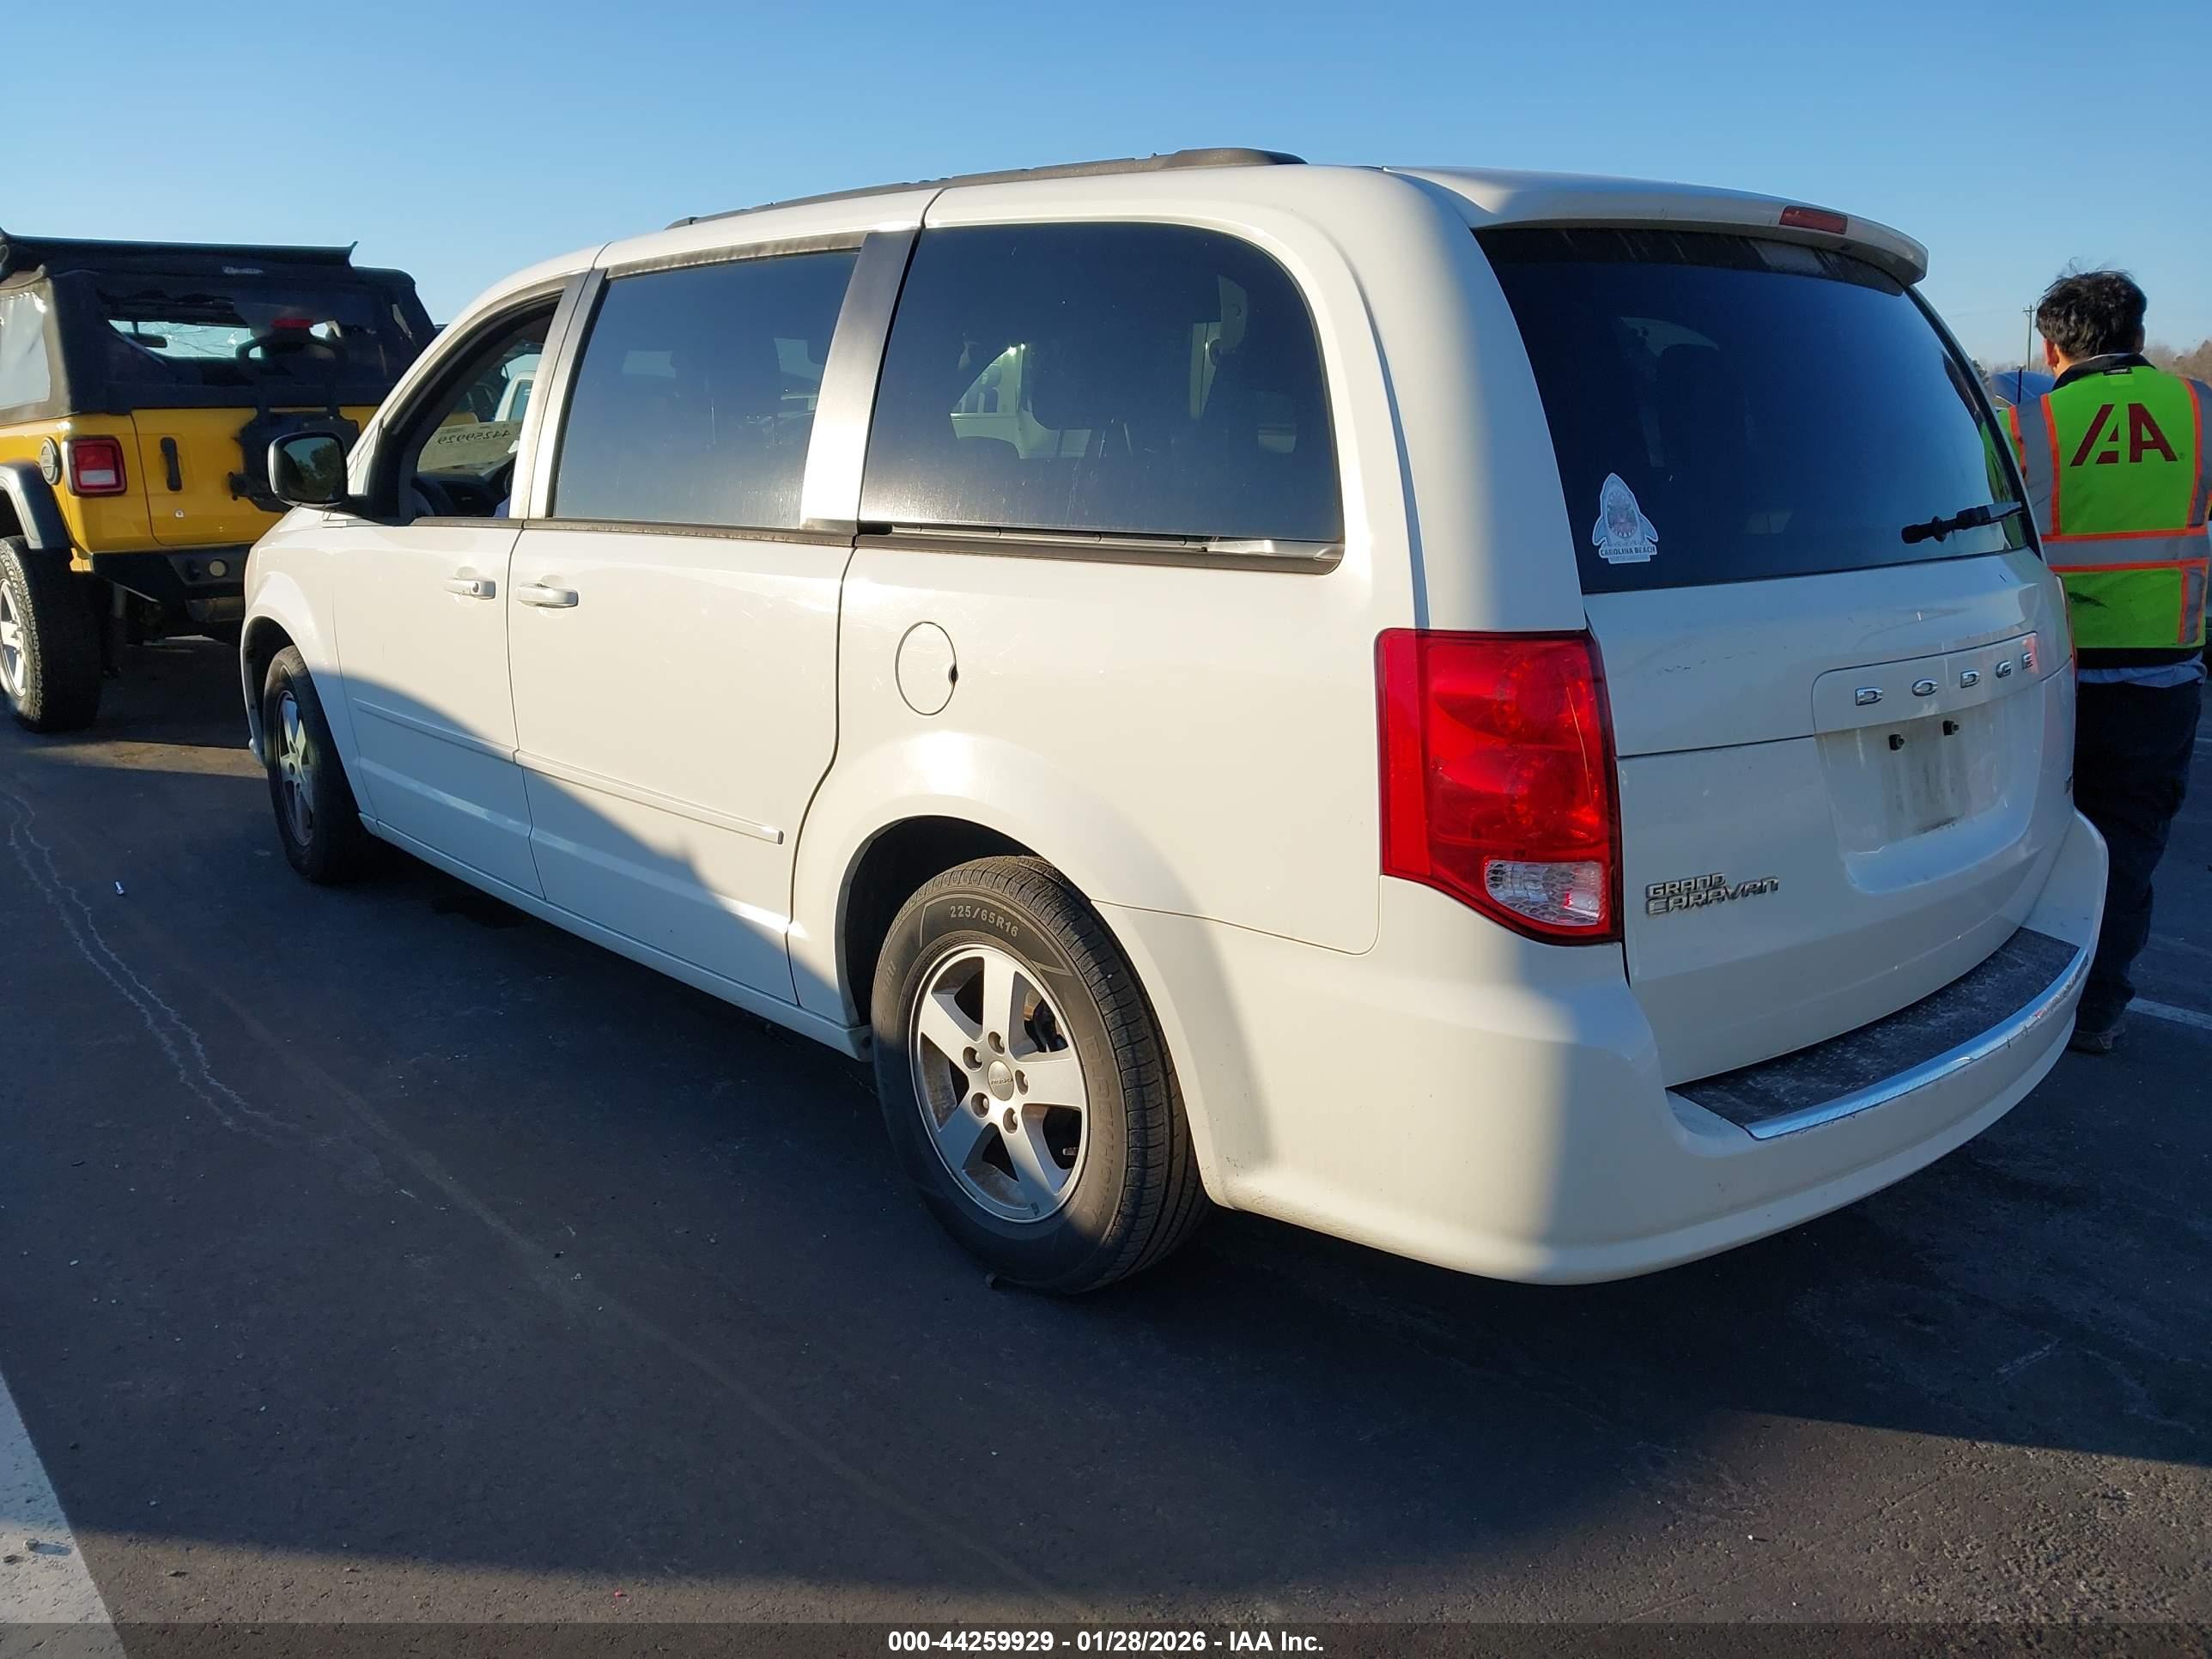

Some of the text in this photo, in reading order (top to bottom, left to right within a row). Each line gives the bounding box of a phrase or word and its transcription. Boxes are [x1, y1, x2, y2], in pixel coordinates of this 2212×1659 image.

[1600, 546, 1656, 556] CAROLINA BEACH
[1855, 652, 2033, 706] DODGE
[1646, 872, 1726, 899] GRAND
[1646, 875, 1779, 915] CARAVAN
[950, 905, 1018, 938] 225/65R16
